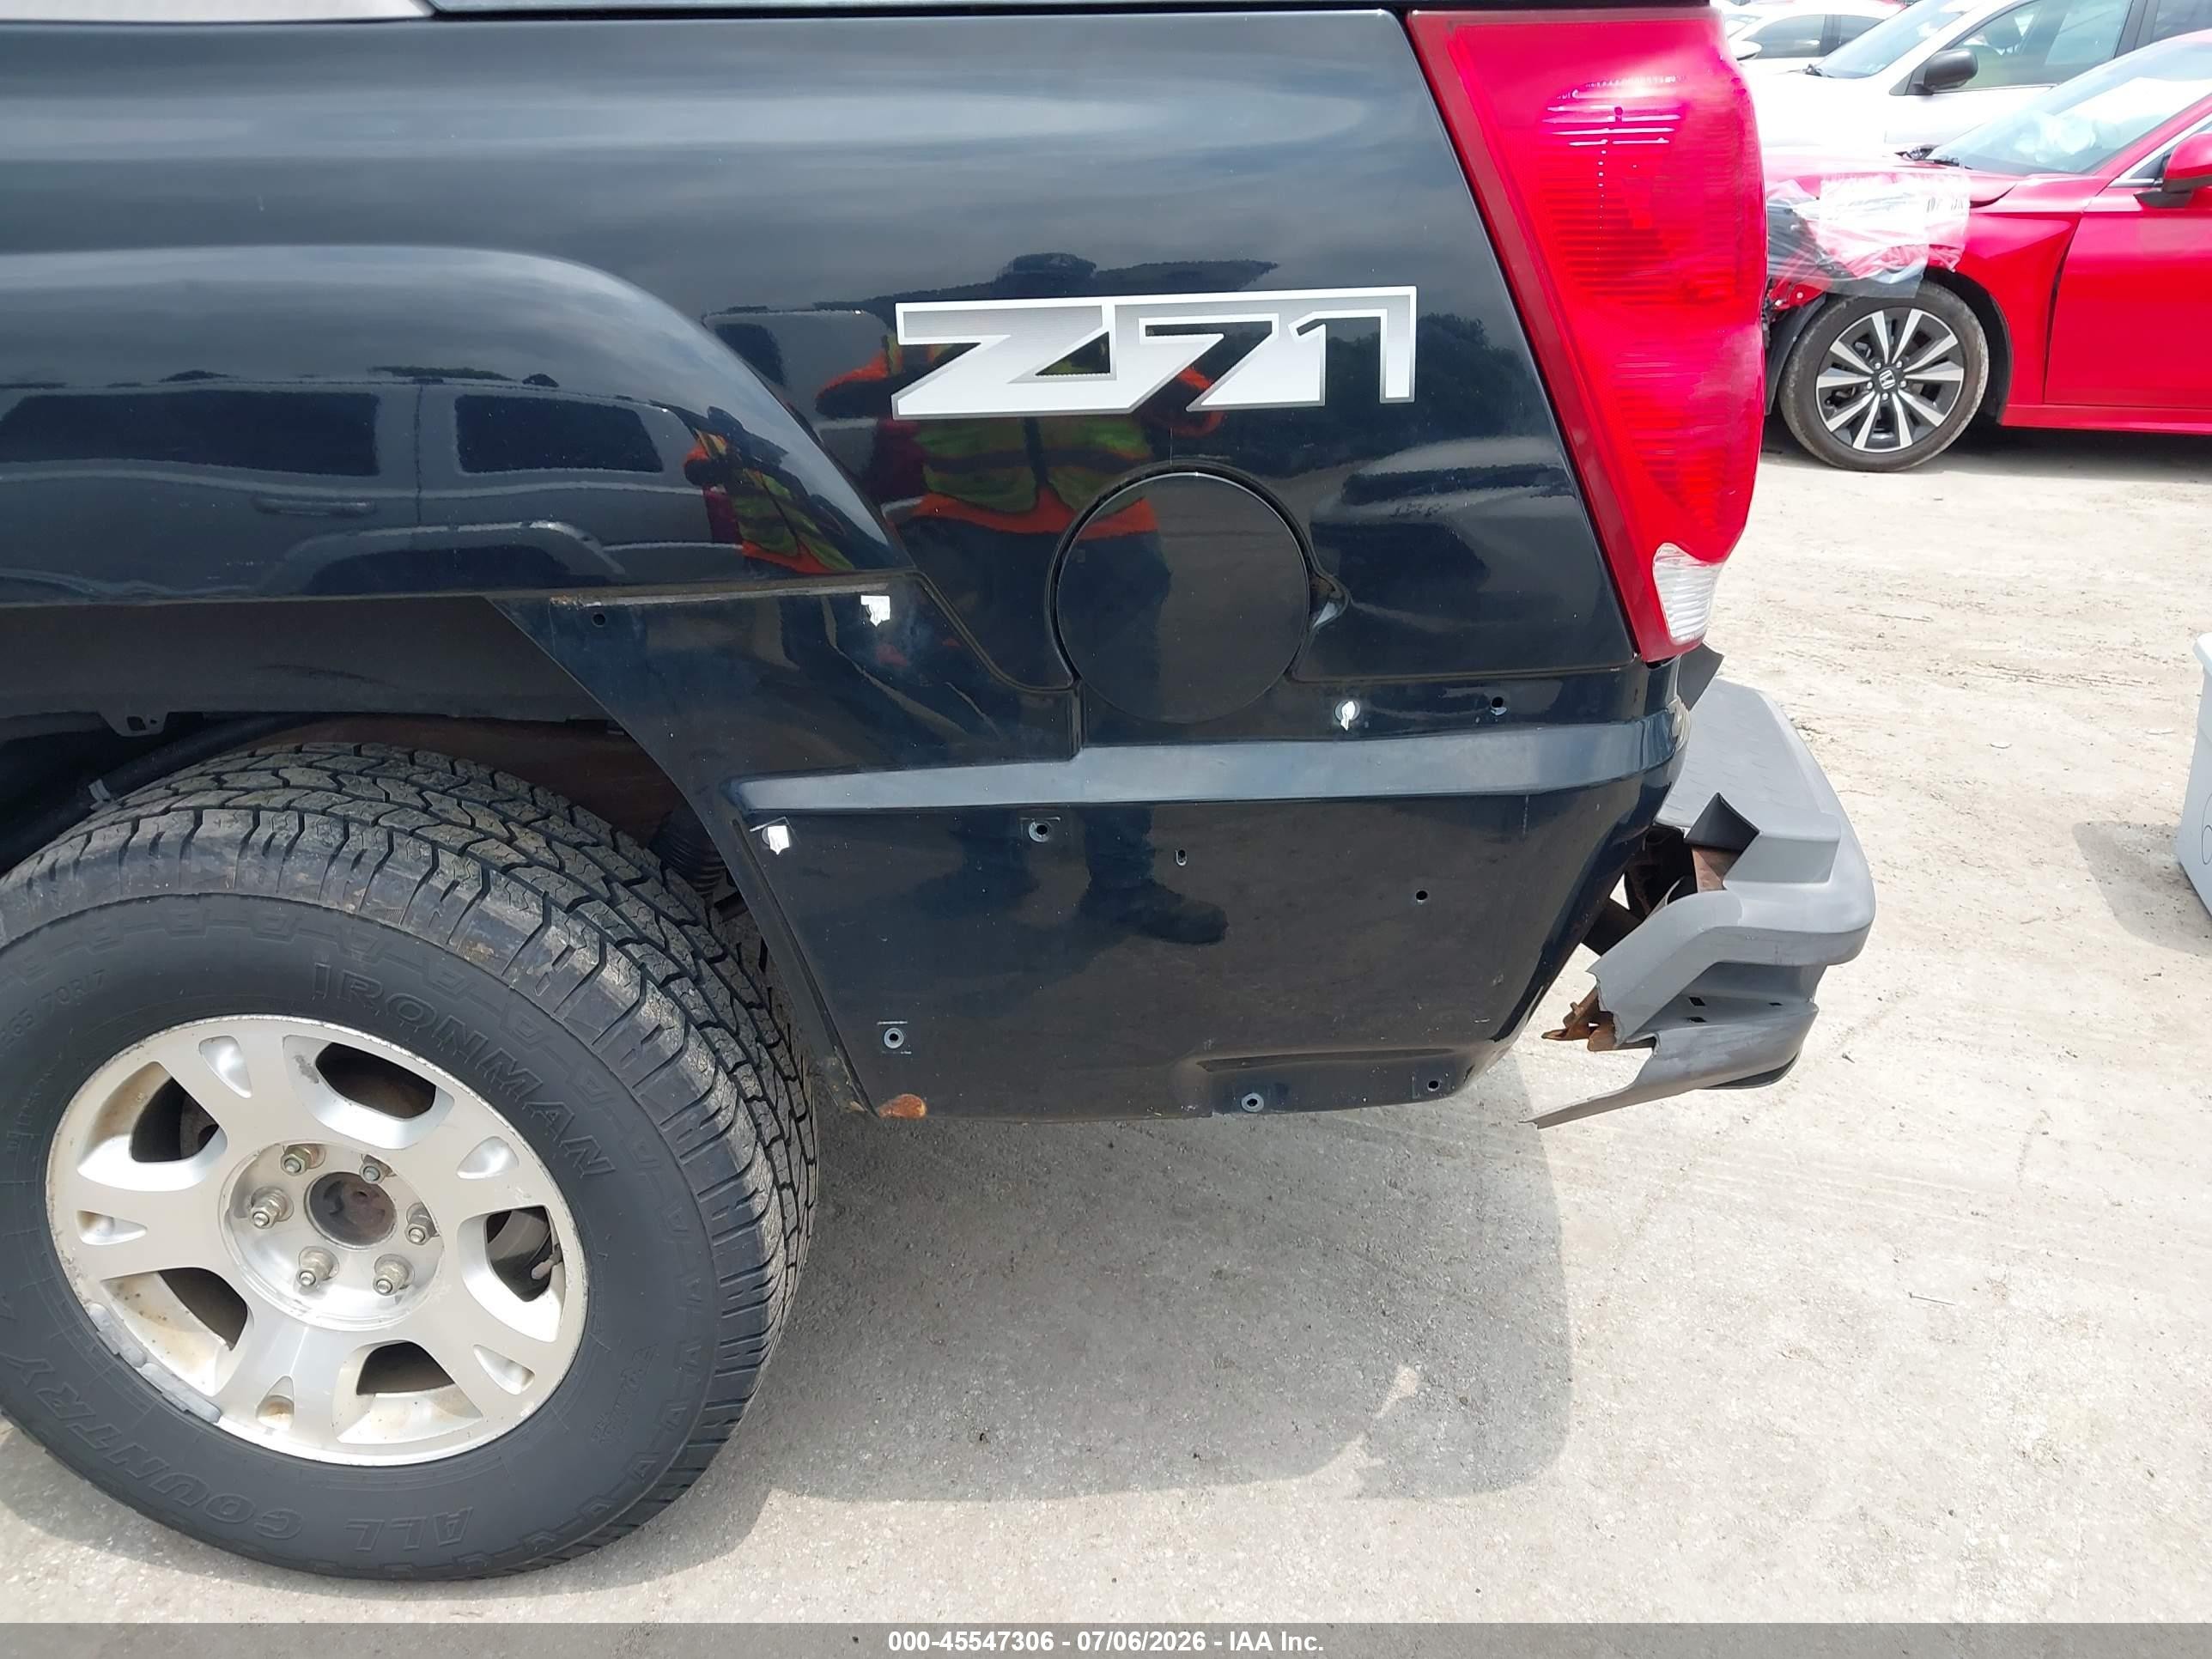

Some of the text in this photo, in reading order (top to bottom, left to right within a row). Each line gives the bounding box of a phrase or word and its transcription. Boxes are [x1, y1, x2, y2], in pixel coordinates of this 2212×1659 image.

[891, 286, 1418, 421] Z71
[311, 961, 617, 1179] IRONMAN
[0, 1351, 475, 1553] ALL COUNTRY
